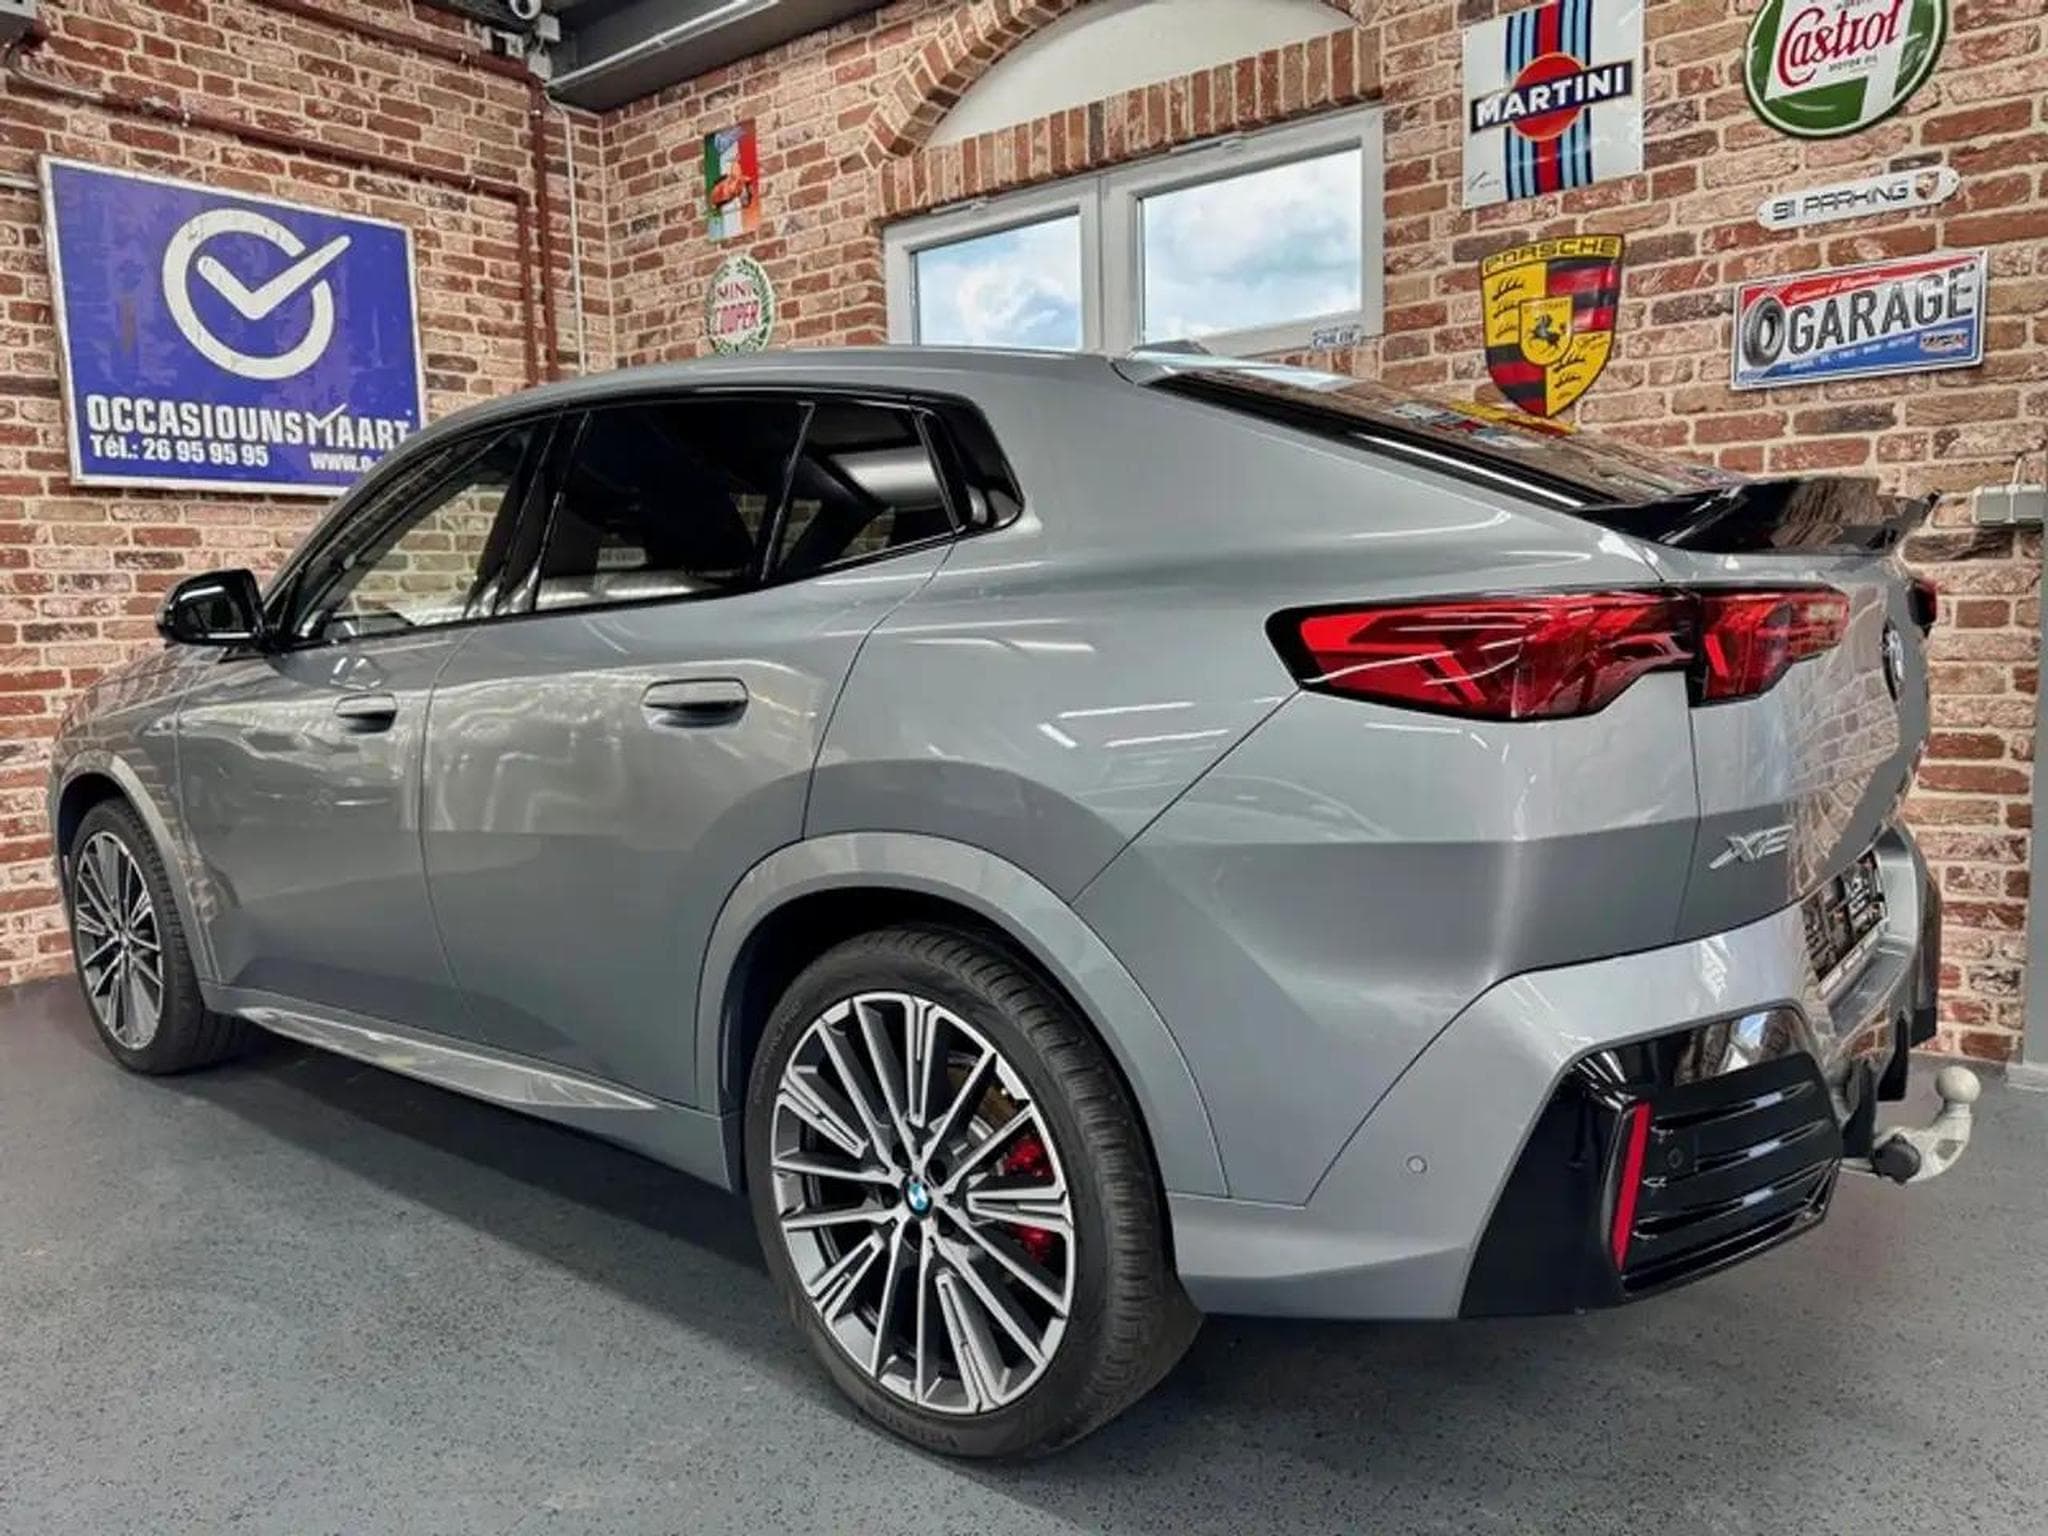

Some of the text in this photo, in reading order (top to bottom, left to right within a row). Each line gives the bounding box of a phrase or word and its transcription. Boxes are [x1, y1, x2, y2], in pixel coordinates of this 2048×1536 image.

[1777, 0, 1905, 87] Castrol
[1476, 66, 1625, 127] MARTINI
[1803, 179, 1910, 217] PARKING
[1485, 236, 1618, 273] PORSCHE
[1787, 263, 1975, 355] GARAGE
[142, 437, 170, 462] 26
[176, 440, 205, 465] 95
[209, 442, 238, 466] 95
[240, 444, 268, 468] 95
